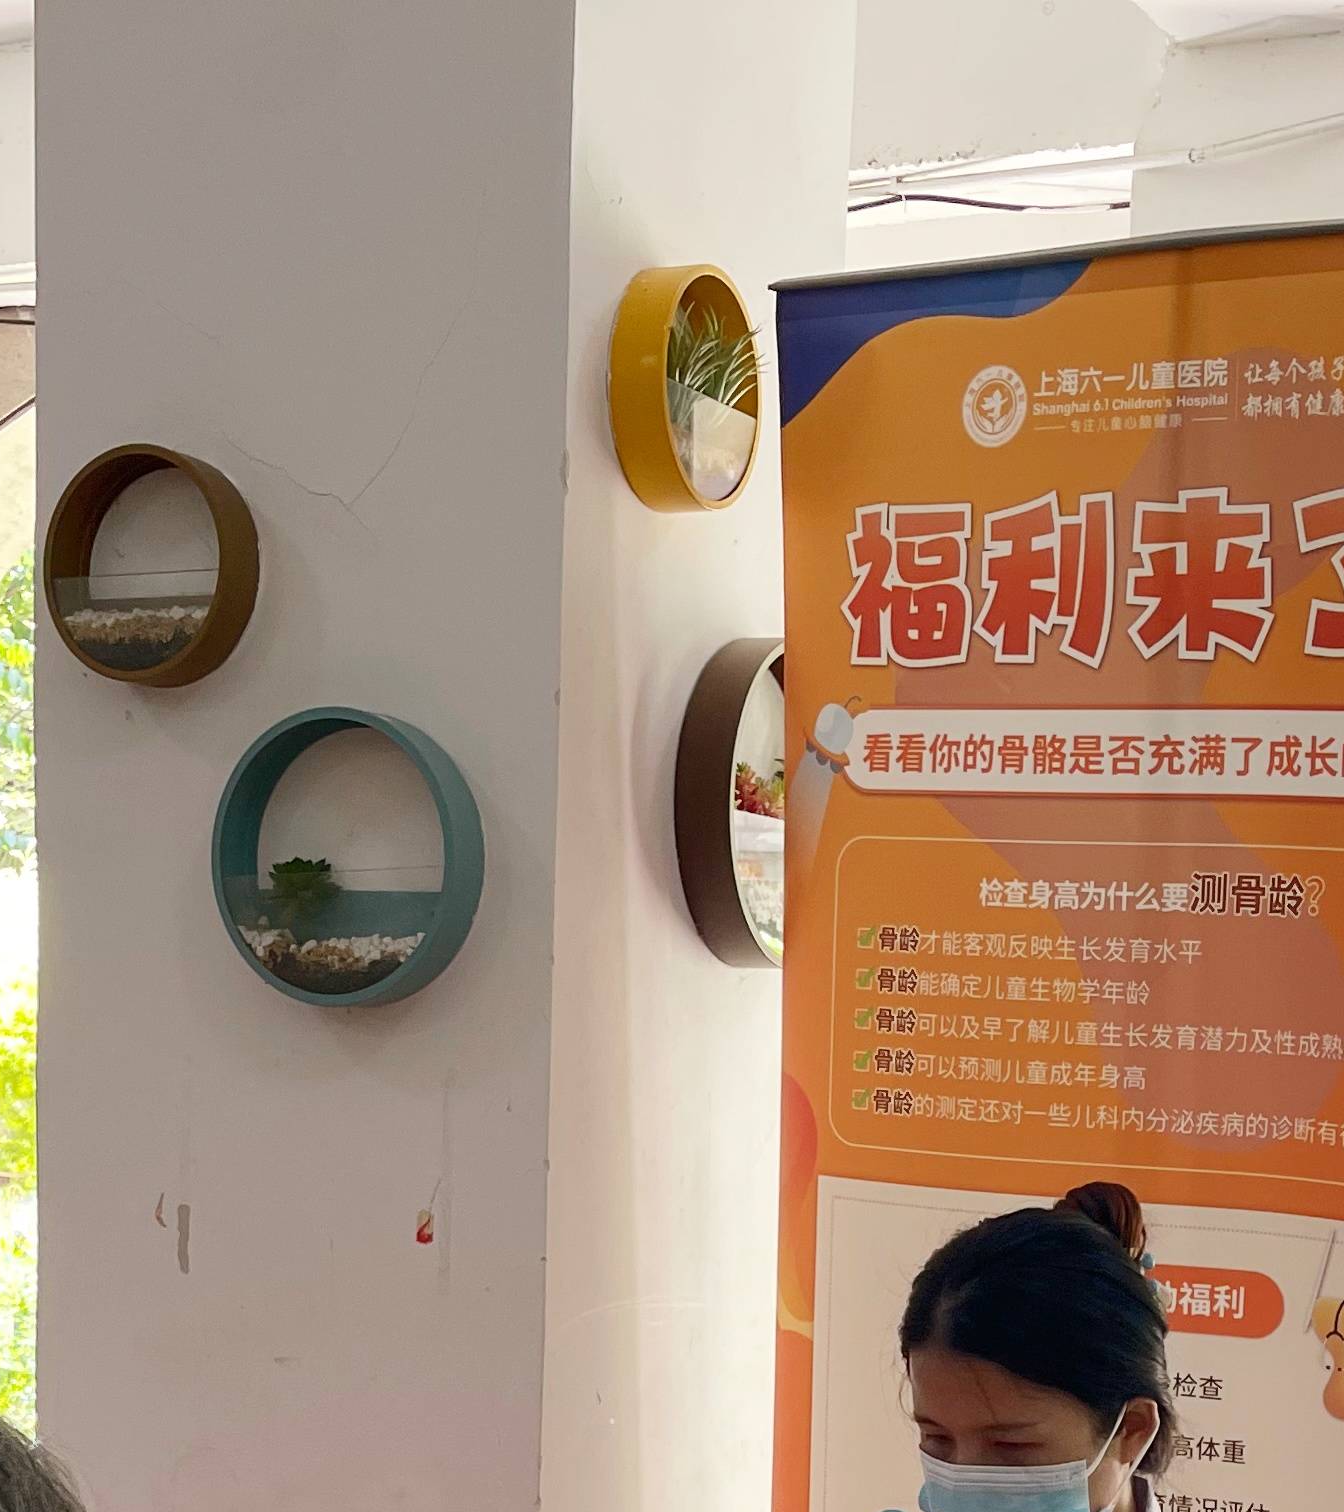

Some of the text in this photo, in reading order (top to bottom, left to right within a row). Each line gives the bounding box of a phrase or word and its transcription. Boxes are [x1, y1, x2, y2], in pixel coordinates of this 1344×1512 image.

[1032, 357, 1229, 398] 上海六一儿童医院
[1032, 401, 1090, 417] Shanghai
[1112, 397, 1173, 411] Children's
[1176, 393, 1229, 410] Hospital
[978, 871, 1327, 919] 检查身高为什么要测骨龄？
[877, 925, 1203, 966] 骨龄才能客观反映生长发育水平
[876, 966, 1151, 1007] 骨龄能确定儿童生物学年龄
[872, 1048, 1147, 1090] 骨龄可以预测儿童成年身高
